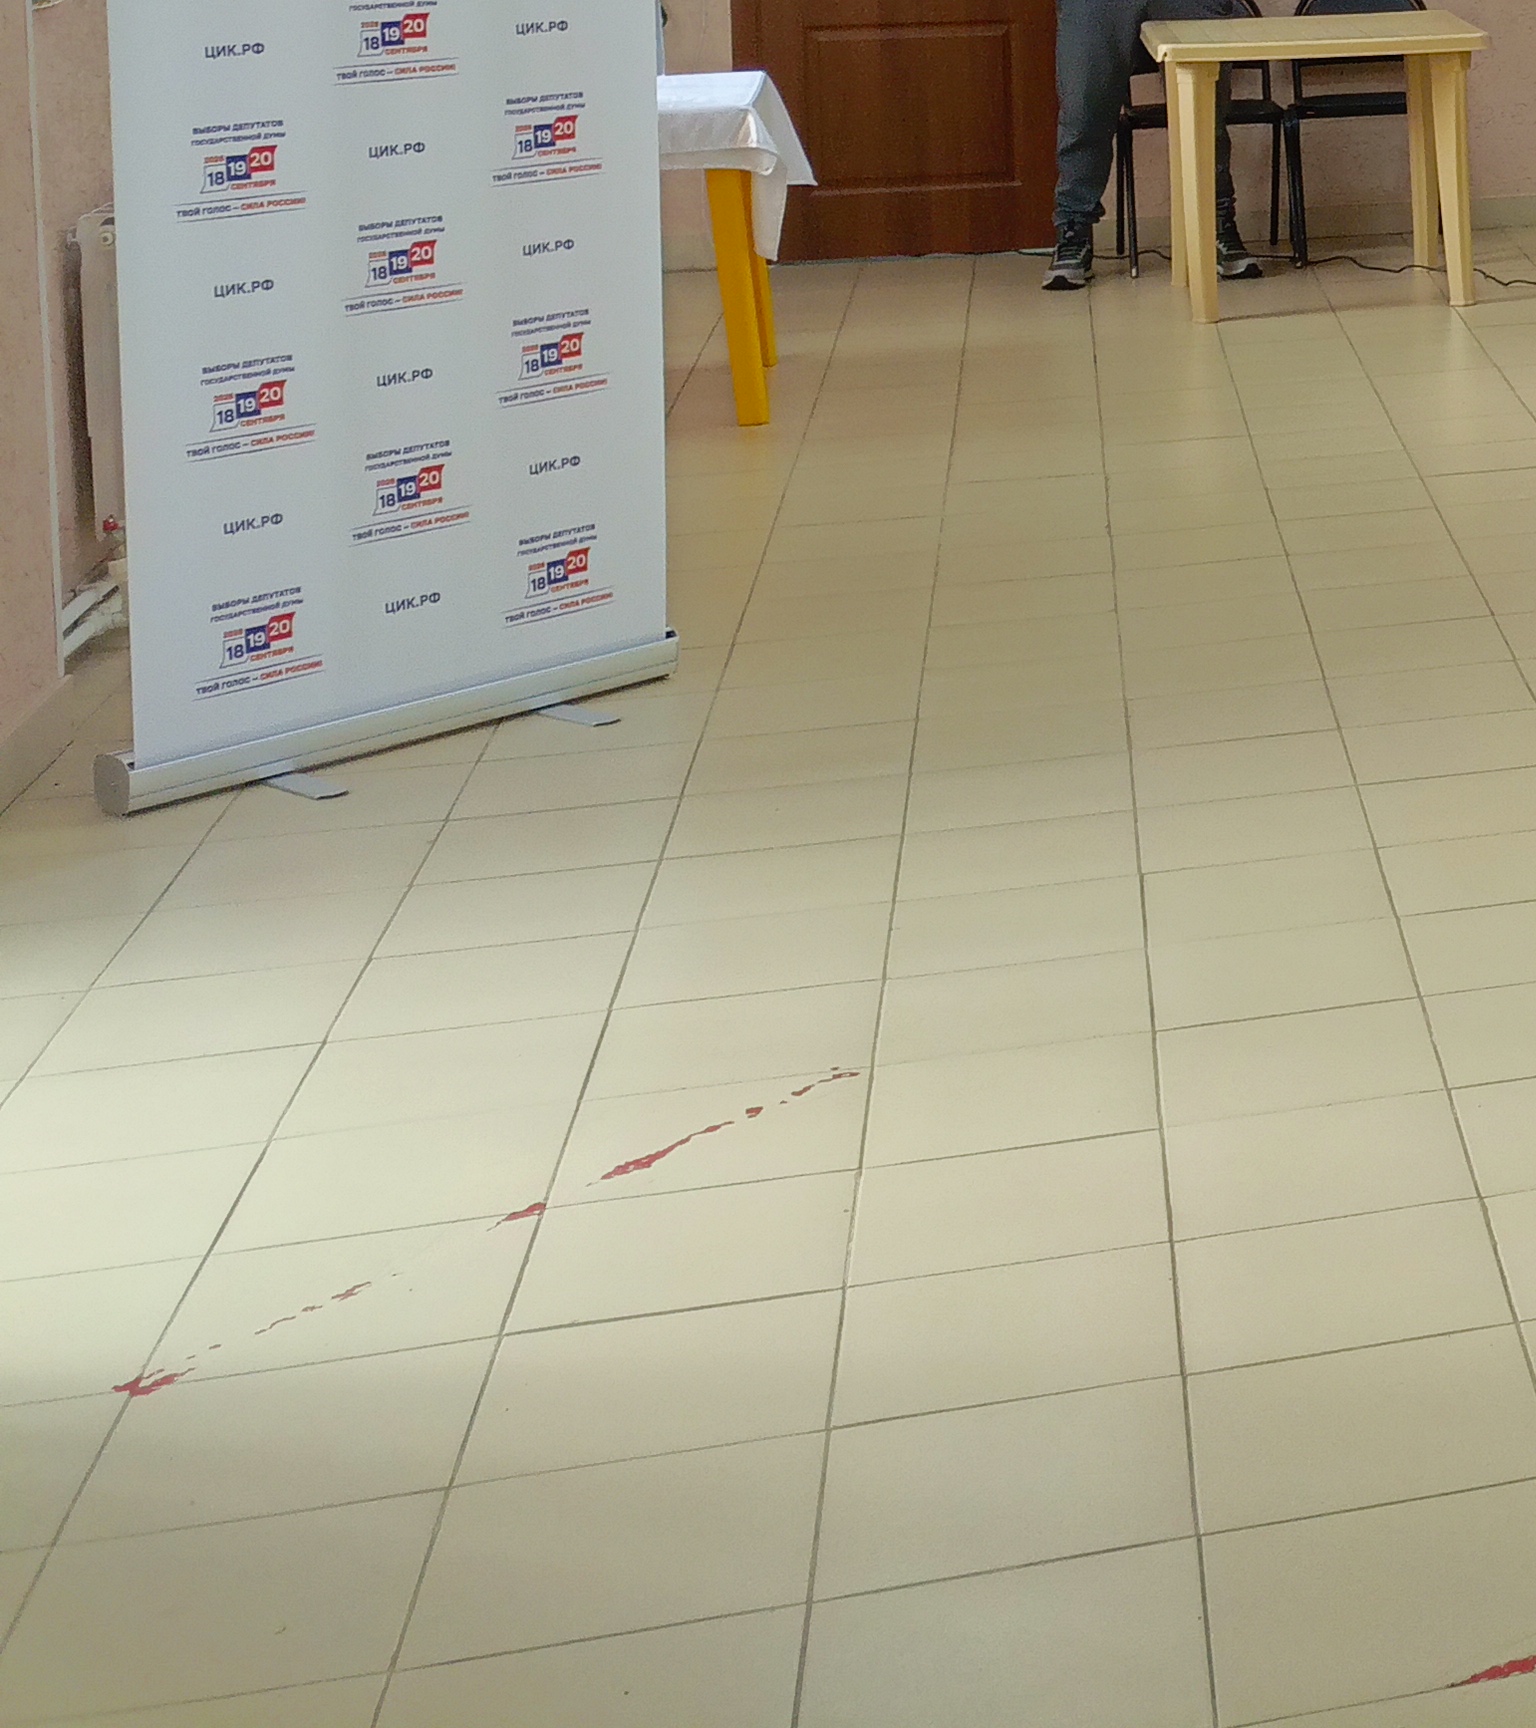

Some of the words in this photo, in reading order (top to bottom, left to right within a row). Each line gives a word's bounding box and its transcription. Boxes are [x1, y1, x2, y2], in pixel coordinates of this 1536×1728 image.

[363, 36, 379, 50] 18
[383, 27, 399, 41] 19
[404, 19, 424, 33] 20
[516, 20, 568, 36] ЦИК.РФ
[205, 43, 264, 59] ЦИК.РФ
[518, 139, 532, 152] 18
[536, 129, 550, 144] 19
[555, 121, 573, 135] 20
[369, 142, 425, 159] ЦИК.РФ
[207, 171, 224, 186] 18
[228, 161, 245, 176] 19
[250, 151, 271, 167] 20
[523, 239, 574, 256] ЦИК.РФ
[371, 266, 387, 280] 18
[391, 255, 407, 271] 19
[411, 246, 431, 261] 20
[214, 279, 274, 298] ЦИК.РФ
[524, 359, 539, 373] 18
[542, 348, 557, 363] 19
[561, 338, 579, 353] 20
[377, 368, 433, 387] ЦИК.РФ
[217, 409, 234, 424] 18
[237, 397, 255, 413] 19
[260, 386, 281, 403] 20
[530, 456, 580, 475] ЦИК.РФ
[379, 493, 395, 508] 18
[399, 481, 415, 497] 19
[419, 470, 439, 487] 20
[224, 513, 283, 535] ЦИК.РФ
[531, 576, 545, 591] 18
[548, 565, 563, 580] 19
[567, 553, 585, 570] 20
[385, 592, 440, 614] ЦИК.РФ
[227, 644, 243, 660] 18
[247, 631, 264, 648] 19
[269, 619, 290, 636] 20
